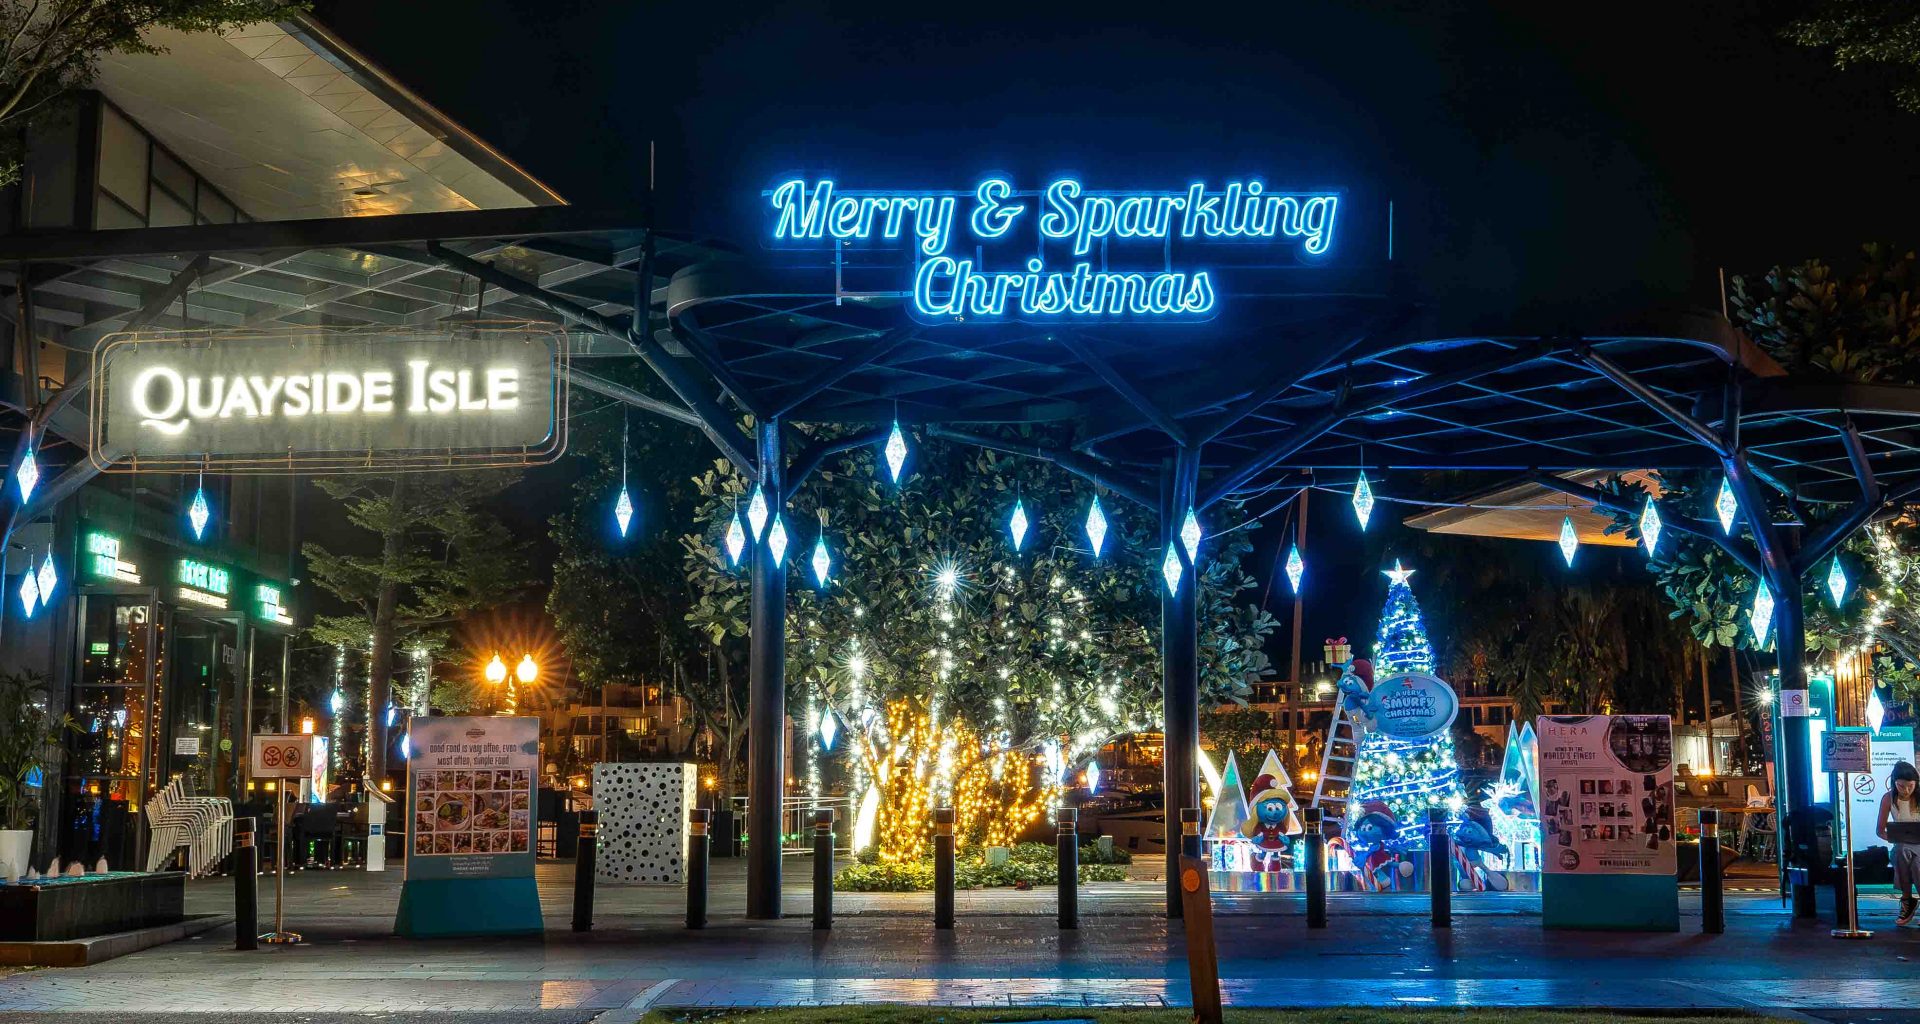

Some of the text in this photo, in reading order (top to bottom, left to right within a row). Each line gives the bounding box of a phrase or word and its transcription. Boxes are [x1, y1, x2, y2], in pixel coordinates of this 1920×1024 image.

[772, 179, 1338, 255] Merry & Sparkling
[914, 255, 1214, 315] Christmas
[132, 359, 520, 436] QUAYSIDE ISLE
[1383, 696, 1436, 710] SMURFY
[1384, 708, 1436, 718] CHRISTMAS
[1548, 727, 1588, 735] HERA
[1573, 752, 1596, 760] FINEST
